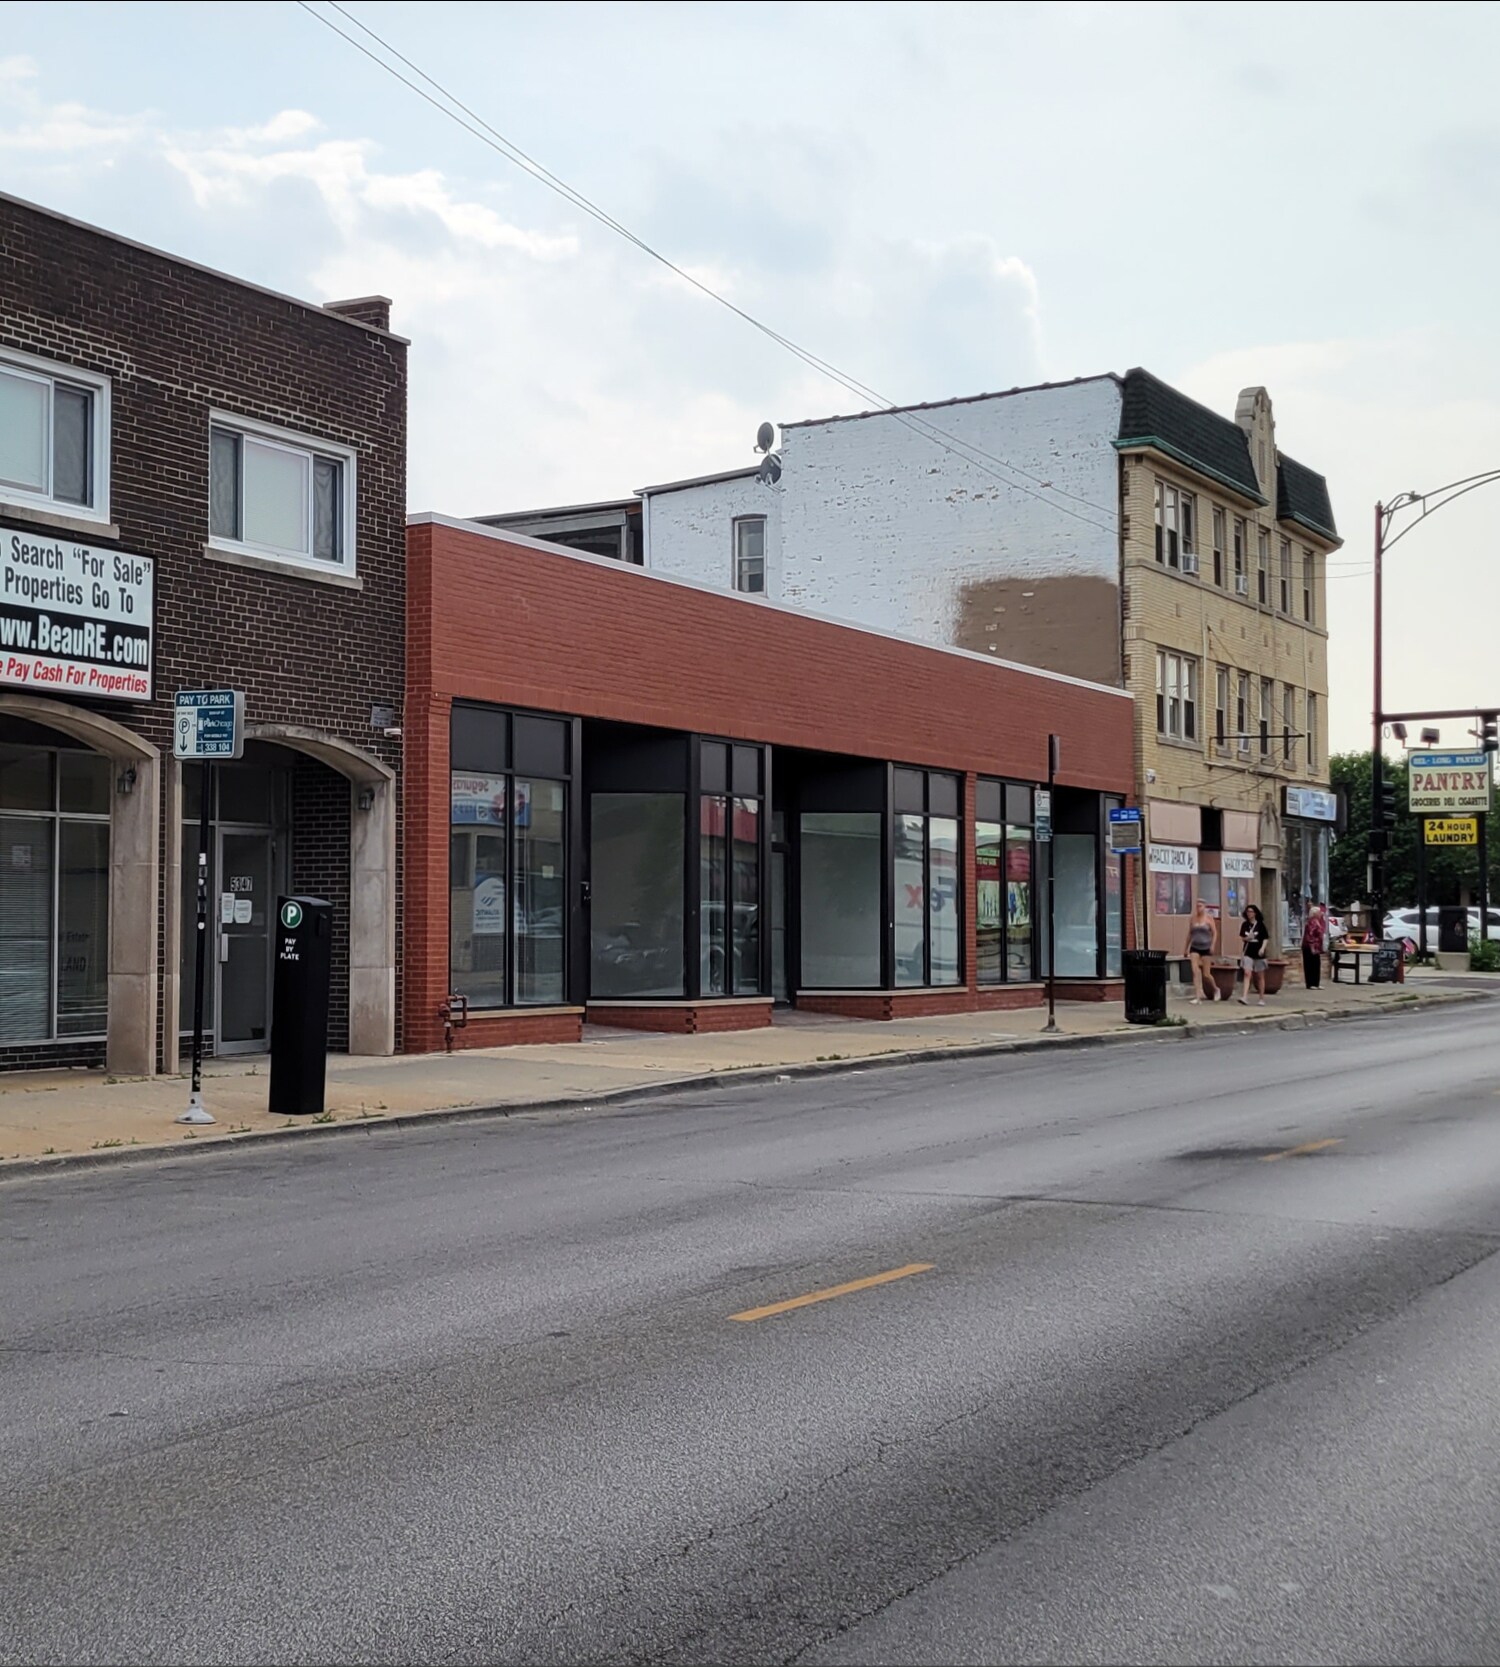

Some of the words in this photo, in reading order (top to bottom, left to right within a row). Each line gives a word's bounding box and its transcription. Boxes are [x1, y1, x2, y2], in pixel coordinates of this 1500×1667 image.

[11, 535, 63, 571] Search
[5, 566, 83, 606] Properties
[92, 582, 110, 610] Go
[119, 587, 134, 614] To
[0, 614, 148, 666] ww.BeauRE.com
[6, 657, 30, 682] Pay
[33, 661, 62, 682] Cash
[66, 666, 86, 685] For
[88, 669, 148, 693] Properties
[179, 695, 194, 705] PAY
[196, 694, 208, 705] TO
[209, 694, 231, 705] PARK
[218, 743, 230, 751] 104
[1412, 771, 1487, 791] PANTRY
[1428, 821, 1444, 831] 24
[1447, 822, 1472, 831] HOUR
[1426, 833, 1474, 843] LAUNDRY
[280, 952, 299, 961] PLATE
